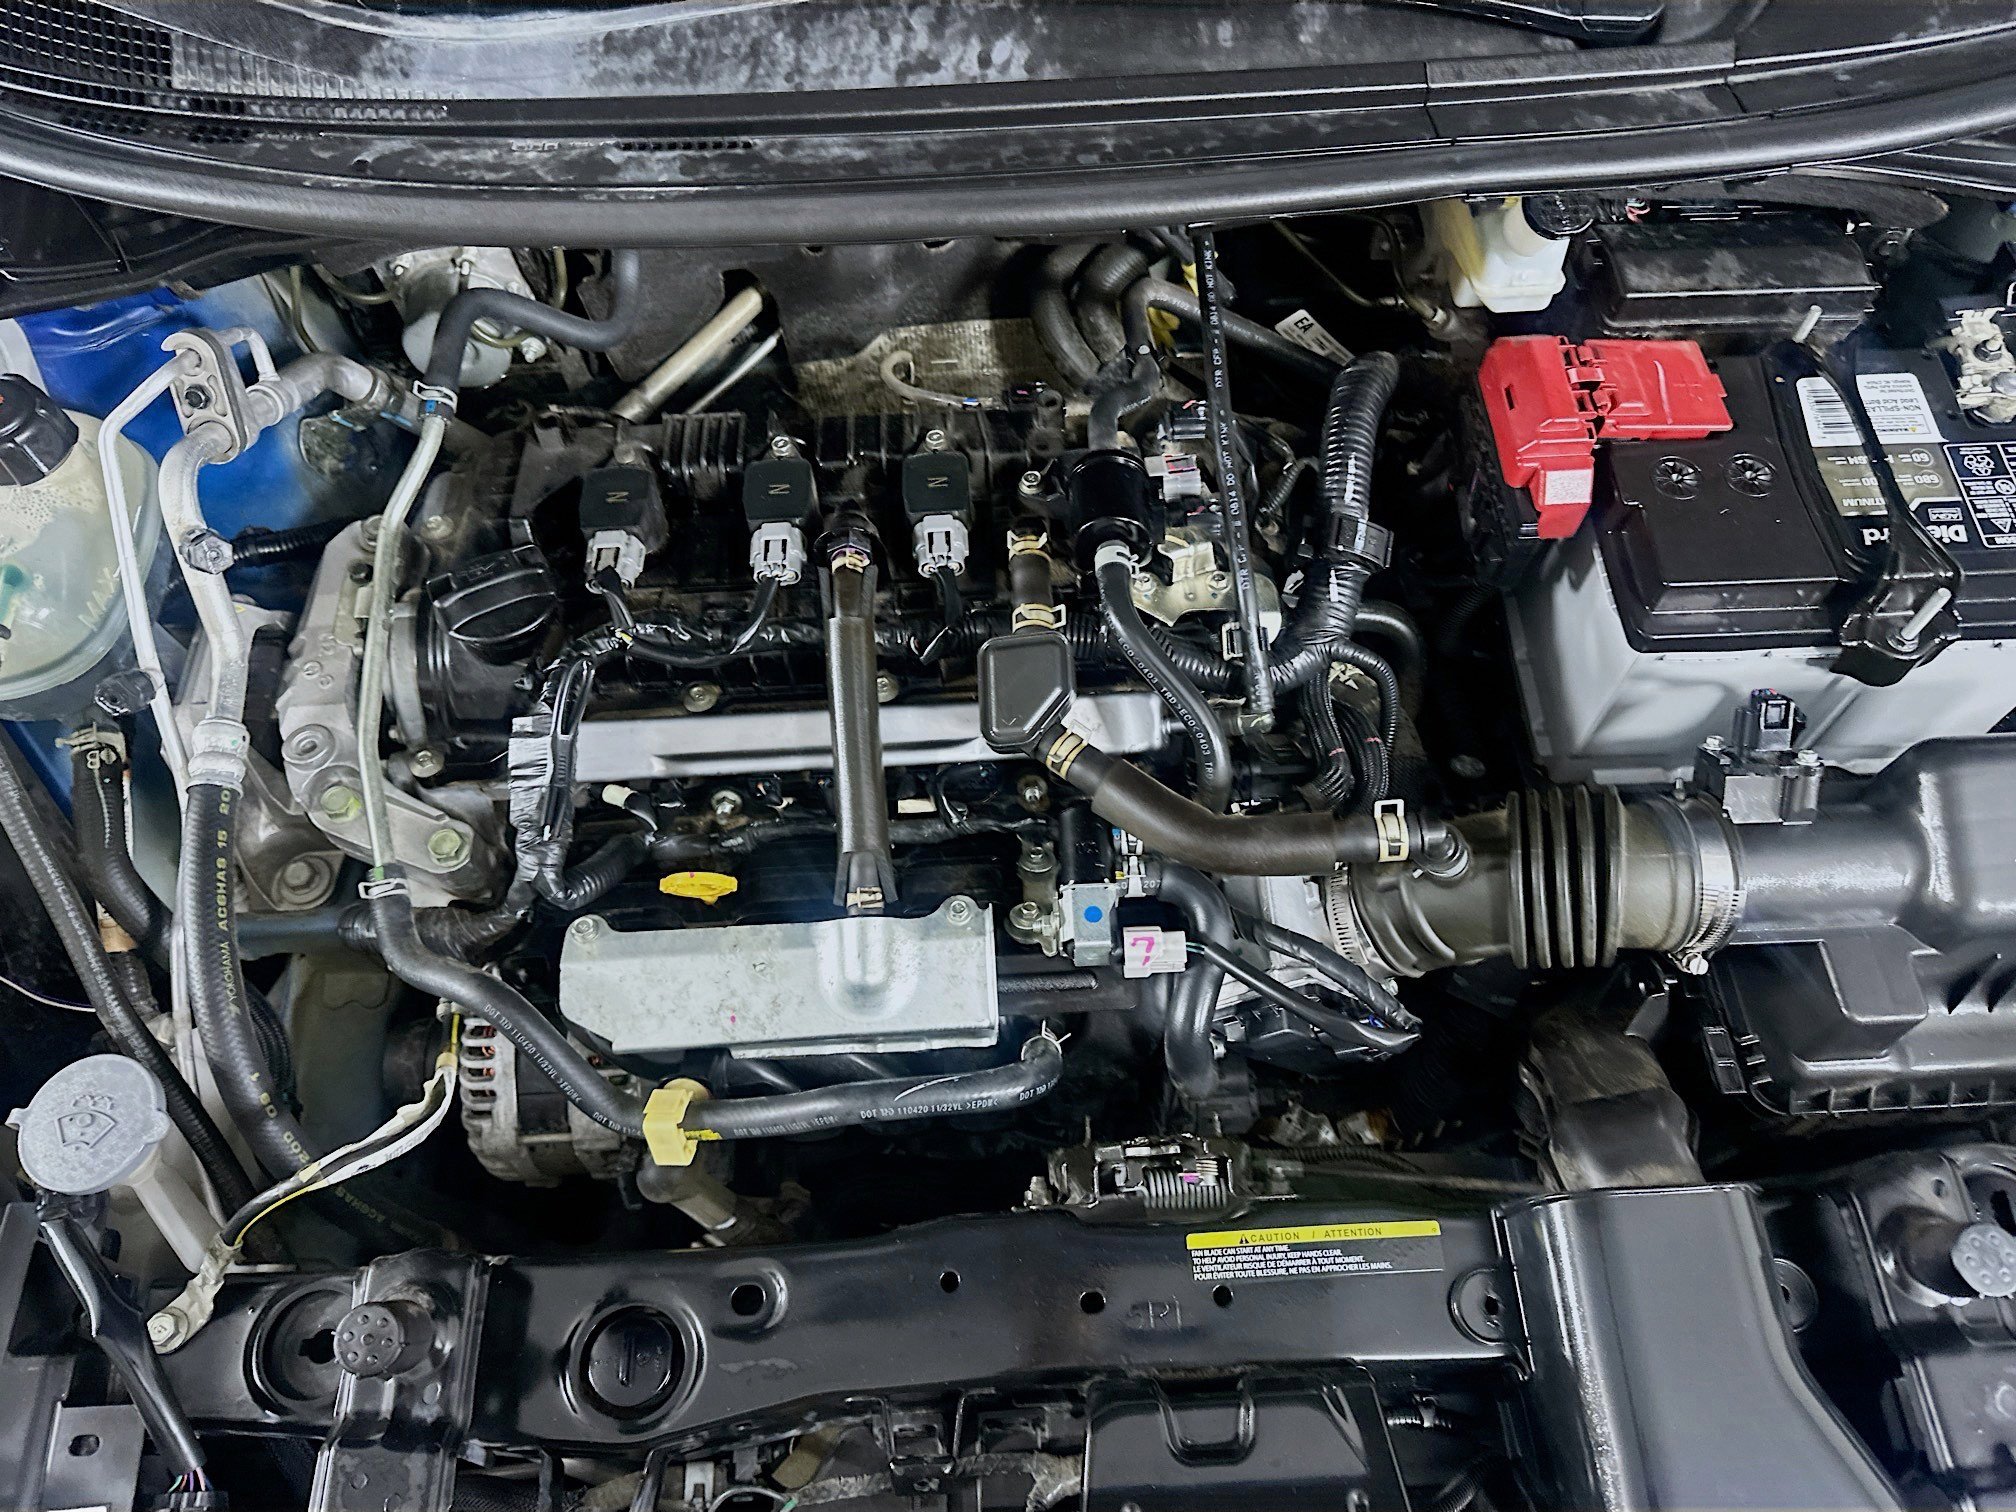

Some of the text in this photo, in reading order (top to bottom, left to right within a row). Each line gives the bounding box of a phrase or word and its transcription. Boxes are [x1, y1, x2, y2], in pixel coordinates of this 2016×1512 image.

[1911, 453, 1929, 462] 60
[1862, 477, 1878, 486] 00
[1914, 474, 1939, 484] 680
[1842, 498, 1886, 507] TINUM
[1862, 525, 1968, 546] Dierd
[1130, 936, 1155, 968] 7
[218, 941, 237, 1001] YOKOHAMA
[1018, 1089, 1033, 1101] DOT
[860, 1109, 876, 1119] DOT
[898, 1105, 928, 1115] 110420
[930, 1102, 962, 1113] 11/32VL
[1250, 1232, 1300, 1243] CAUTION
[1324, 1228, 1382, 1238] ATTENTION
[1192, 1249, 1202, 1257] FAN
[1204, 1248, 1222, 1257] BLADE
[1223, 1247, 1236, 1256] CAN
[1236, 1247, 1254, 1255] START
[1202, 1257, 1216, 1265] HELP
[1217, 1255, 1236, 1264] AVOID
[1236, 1254, 1265, 1263] PERSONAL
[1287, 1251, 1302, 1260] KEEP
[1303, 1250, 1322, 1259] HANDS
[1194, 1272, 1212, 1281] POUR
[1213, 1270, 1234, 1280] ÉVITER
[1235, 1270, 1255, 1279] TOUTE
[1299, 1266, 1311, 1275] PAS
[1322, 1264, 1359, 1273] APPROCHER
[1359, 1263, 1370, 1271] LES
[1202, 1263, 1242, 1273] VENTILATEUR
[1243, 1261, 1266, 1270] RISQUE
[1277, 1259, 1312, 1268] DÉMARRER
[1317, 1257, 1334, 1266] TOUT
